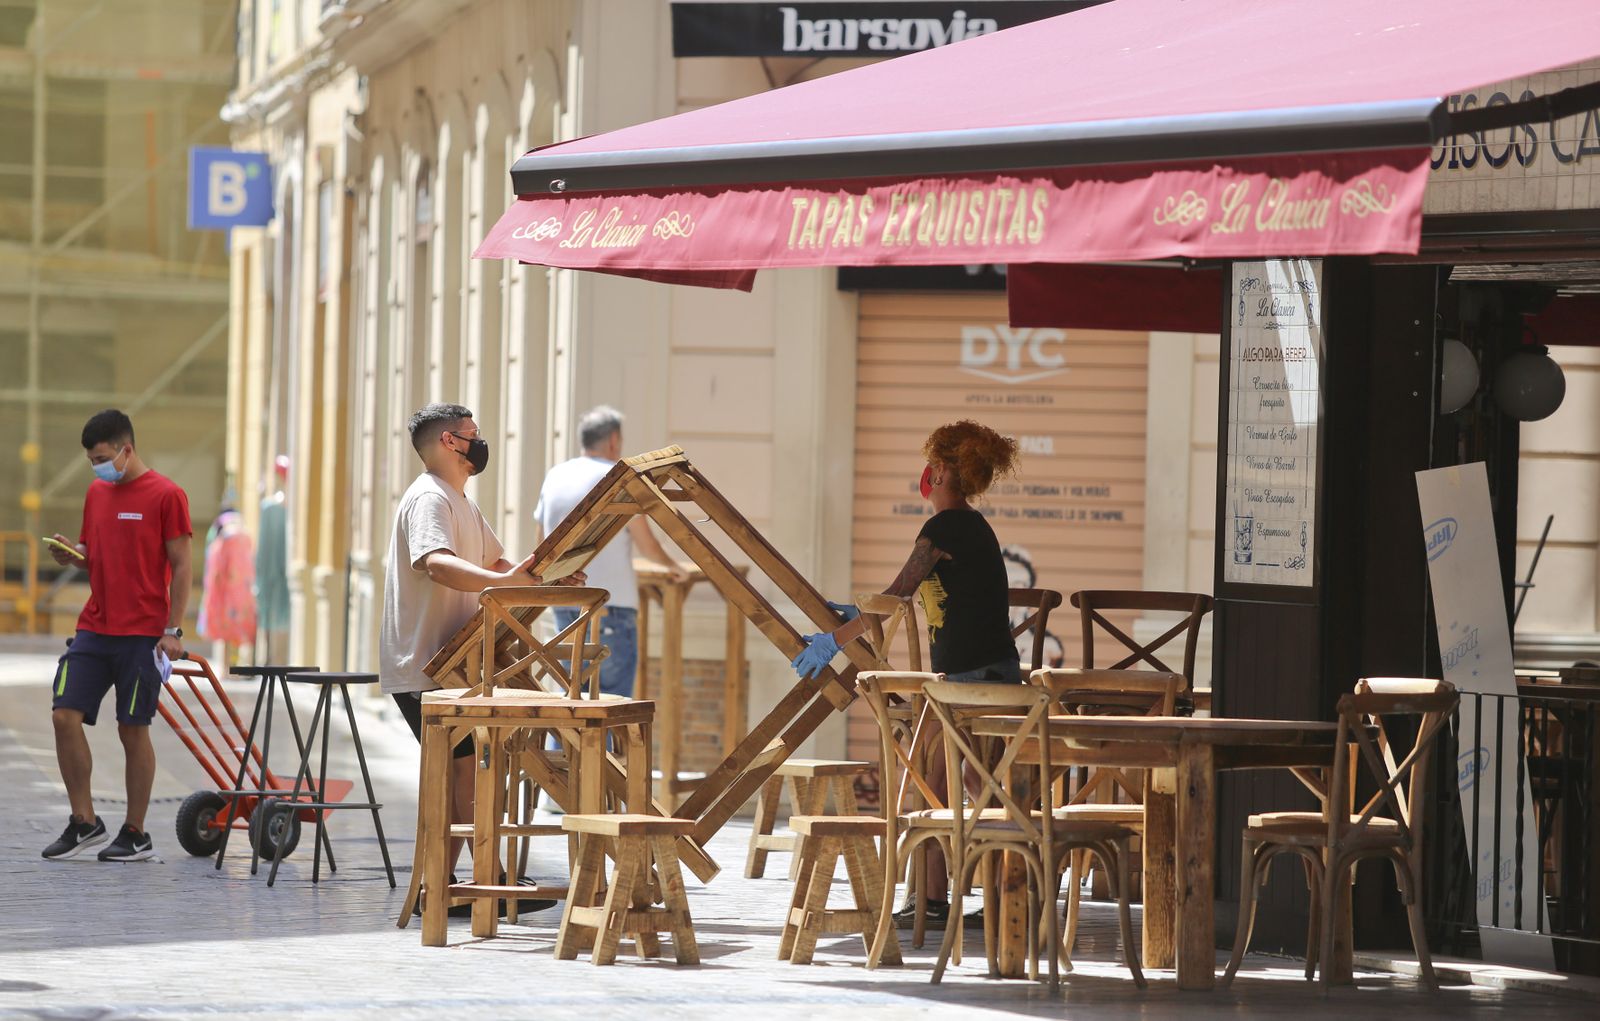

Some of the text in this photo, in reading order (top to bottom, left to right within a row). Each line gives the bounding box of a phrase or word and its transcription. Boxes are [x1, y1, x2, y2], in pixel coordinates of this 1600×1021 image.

[779, 7, 998, 51] barsovia
[208, 161, 247, 216] B
[1211, 178, 1331, 234] La Clasica
[559, 206, 648, 248] La Clasica
[787, 186, 1049, 249] TAPAS EXQUISITAS
[1256, 297, 1269, 317] La
[960, 325, 1067, 370] DYC
[1243, 347, 1265, 362] ALGO
[1265, 347, 1284, 362] PARA
[1270, 427, 1277, 440] de
[1246, 455, 1296, 470] Vinos de Barril
[1244, 488, 1295, 508] Vinos Escogidos
